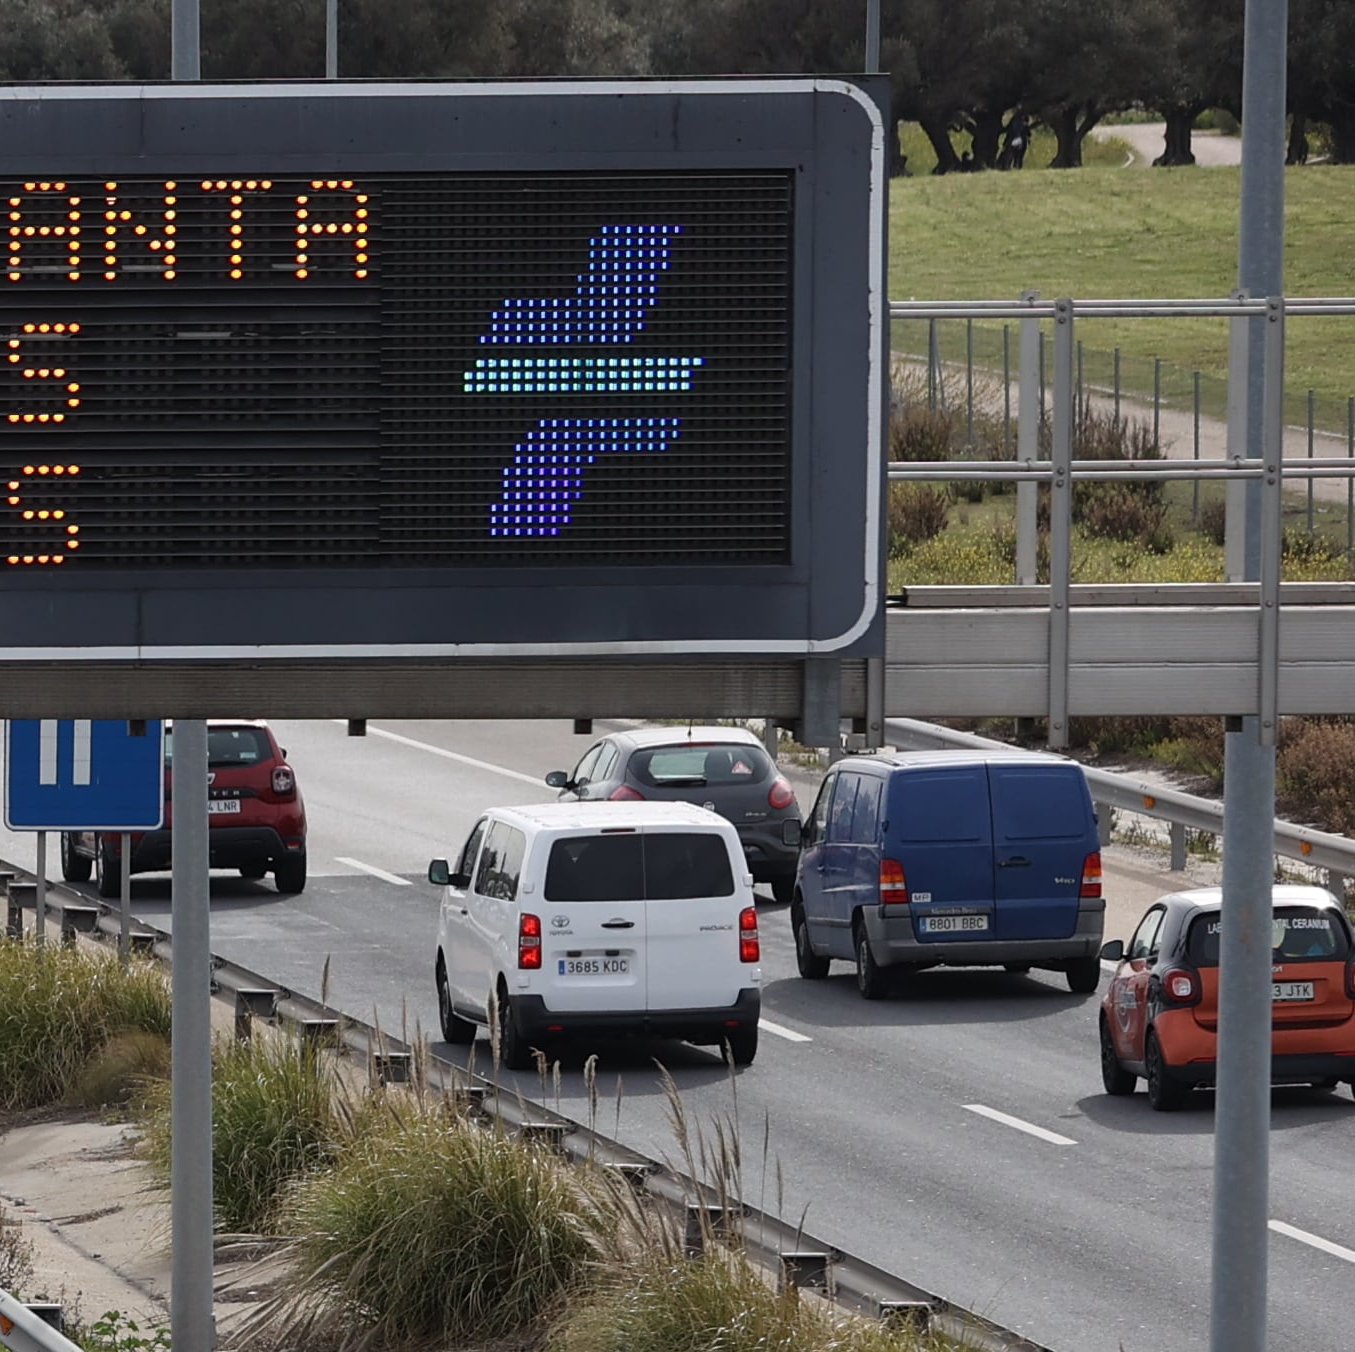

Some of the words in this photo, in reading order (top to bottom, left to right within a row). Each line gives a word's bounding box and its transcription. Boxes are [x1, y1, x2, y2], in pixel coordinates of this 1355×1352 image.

[929, 918, 957, 930] 8801
[962, 917, 986, 929] BBC
[567, 961, 600, 973] 3685
[603, 960, 627, 973] KDC
[1287, 985, 1311, 997] JTK
